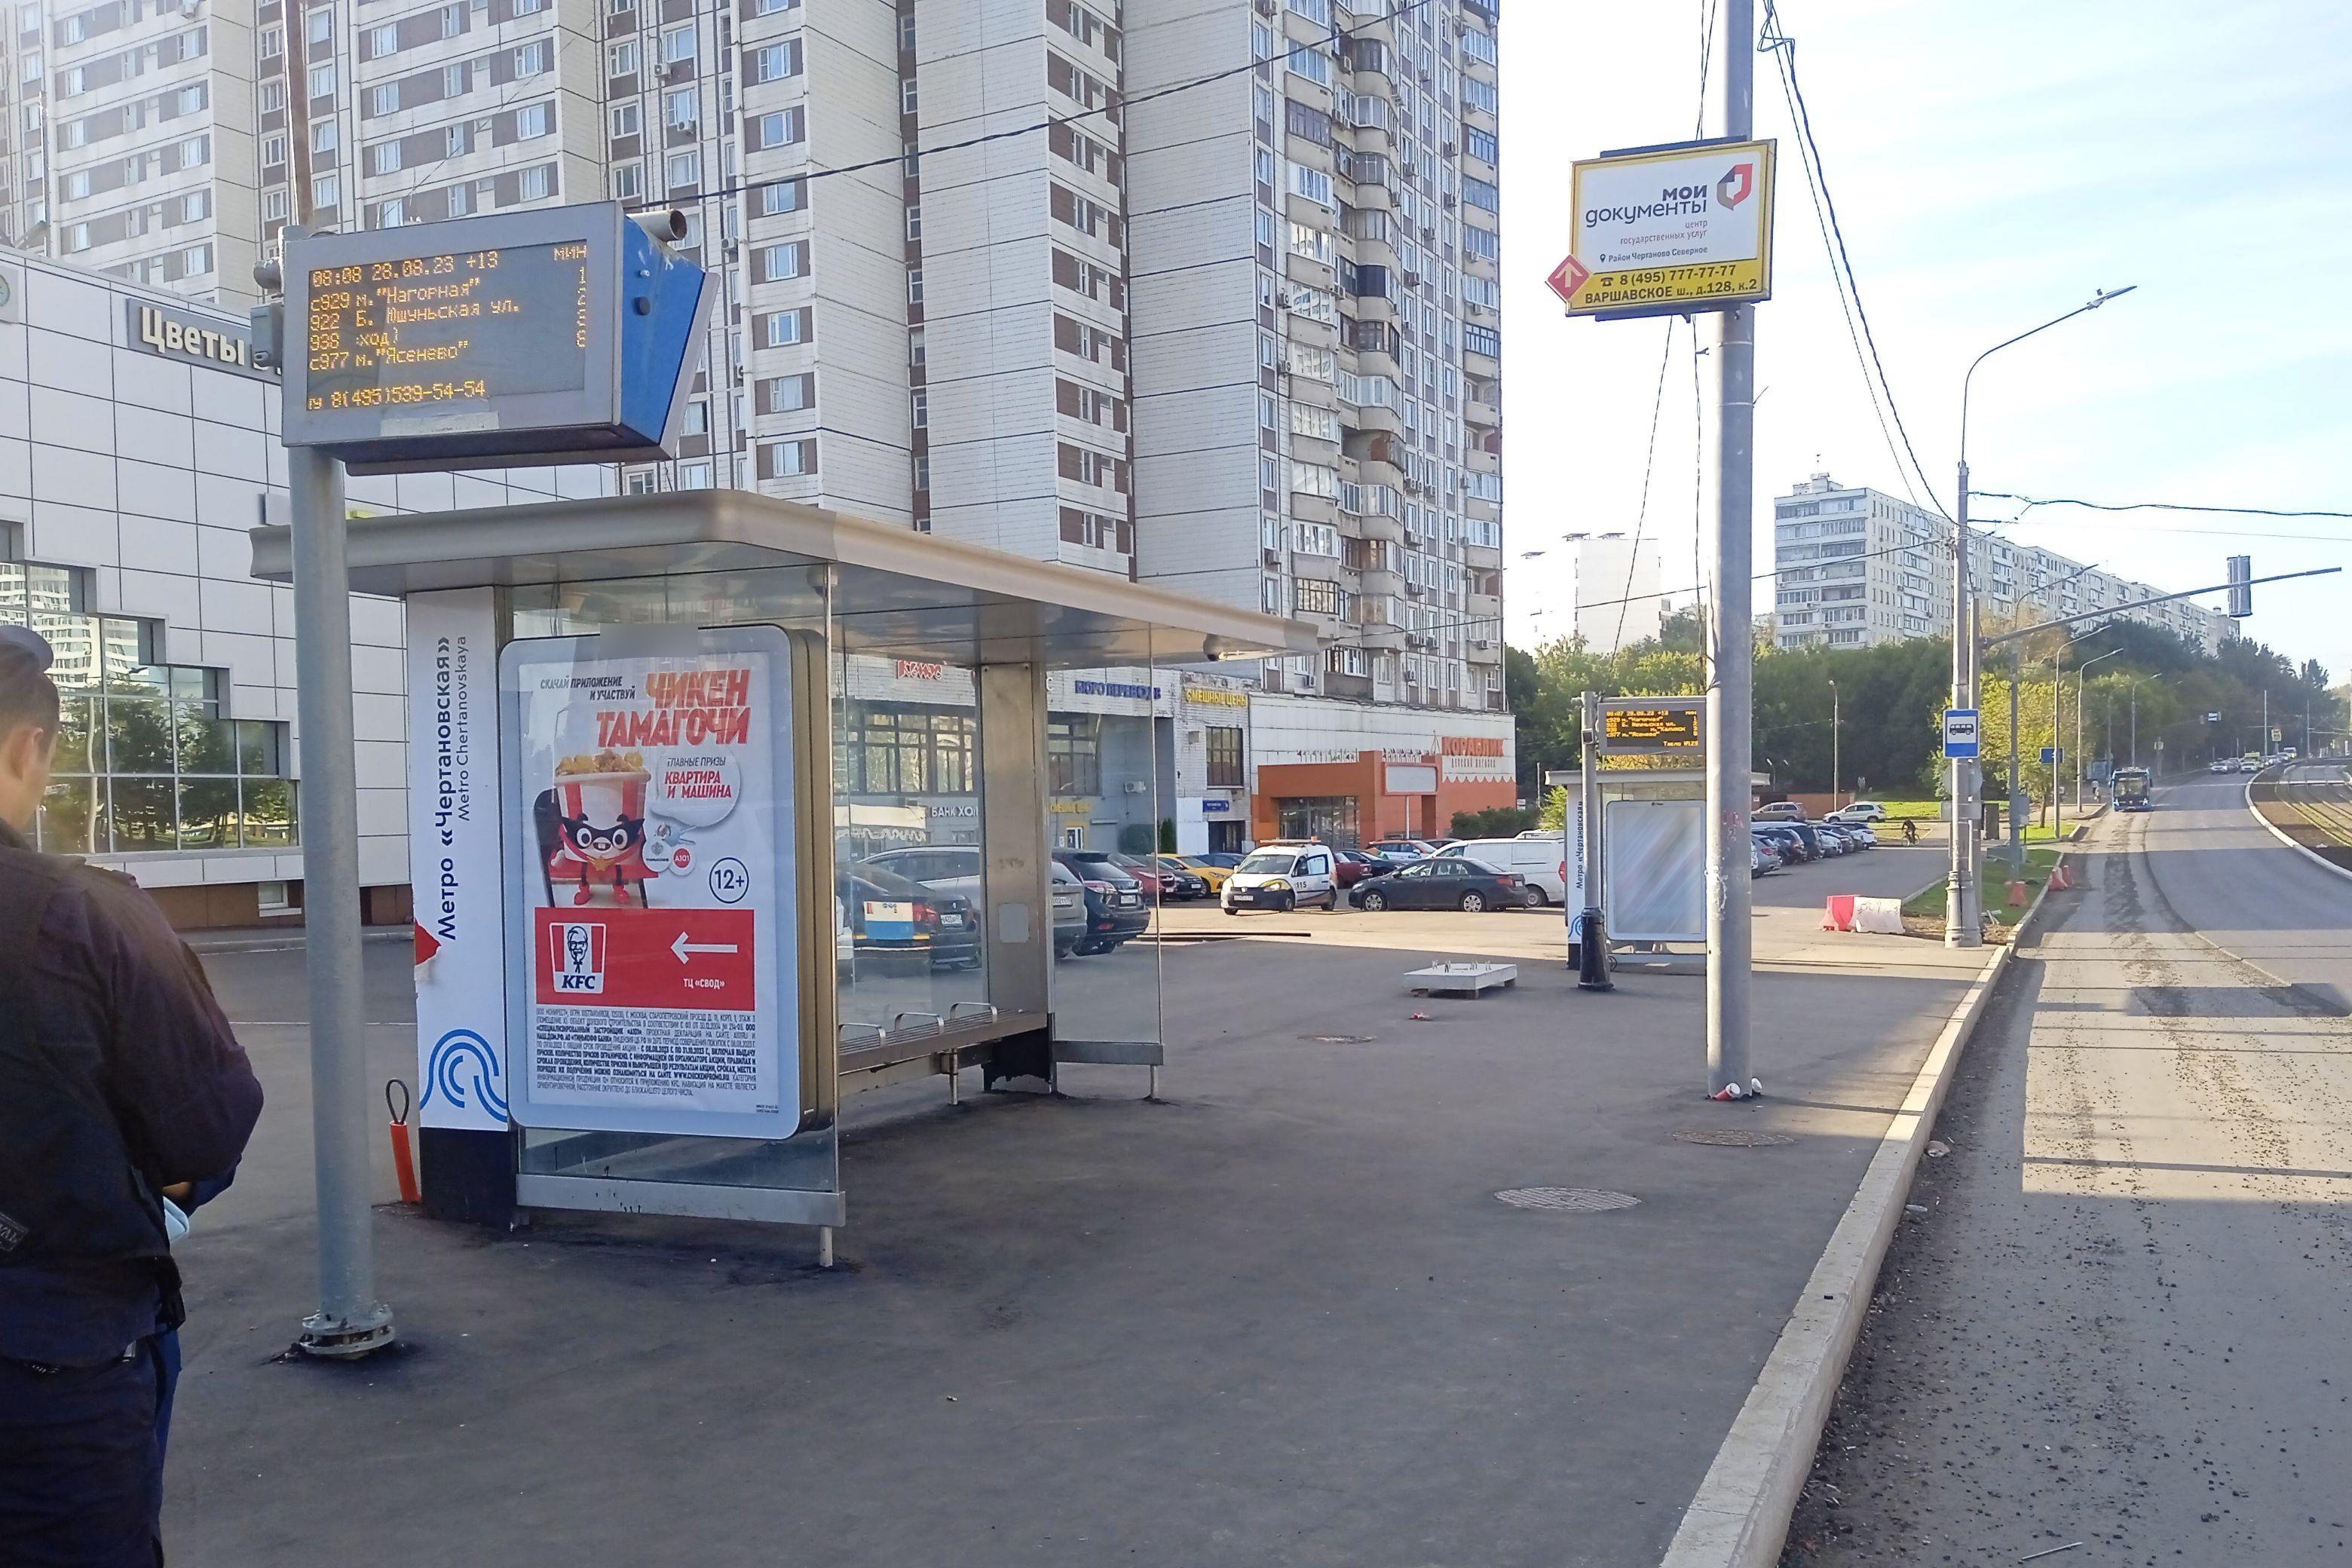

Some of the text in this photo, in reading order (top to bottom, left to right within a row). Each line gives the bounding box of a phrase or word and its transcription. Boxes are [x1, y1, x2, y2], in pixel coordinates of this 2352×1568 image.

[1585, 200, 1707, 228] документы
[1685, 219, 1707, 229] центр
[1620, 230, 1707, 246] государственных услуг
[467, 250, 499, 269] +13
[1609, 246, 1708, 263] Район Чертаново Северное
[1620, 265, 1736, 287] 8 (495) 777-77-77
[1585, 286, 1672, 305] ВАРШАВСКОЕ
[1738, 279, 1757, 291] к.2
[311, 314, 340, 332] 922
[357, 310, 374, 327] Б.
[492, 300, 520, 314] ул.
[141, 305, 246, 366] Цветы
[541, 675, 623, 690] СКАЧАЙ ПРИЛОЖЕНИЕ
[590, 684, 636, 701] И УЧАСТВУЙ
[646, 669, 751, 709] ЧИКЕН
[1186, 688, 1248, 708] СМЕШНЫЕ ЦЕНЫ
[455, 635, 470, 821] Metro Chertanovskaya
[596, 706, 751, 747] ТАМАГОЧИ
[1442, 737, 1505, 757] КОРАБЛИК
[667, 756, 726, 767] ГЛАВНЫЕ ПРИЗЫ
[664, 770, 721, 785] КВАРТИРА
[434, 636, 458, 940] Метро «Чертановская»
[667, 784, 731, 798] И МАШИНА
[931, 806, 956, 817] БАНК
[1576, 801, 1585, 890] Метро «Чертановская»
[714, 869, 745, 890] 12+
[561, 975, 596, 990] KFC
[683, 978, 725, 989] ТЦ «СВОД»
